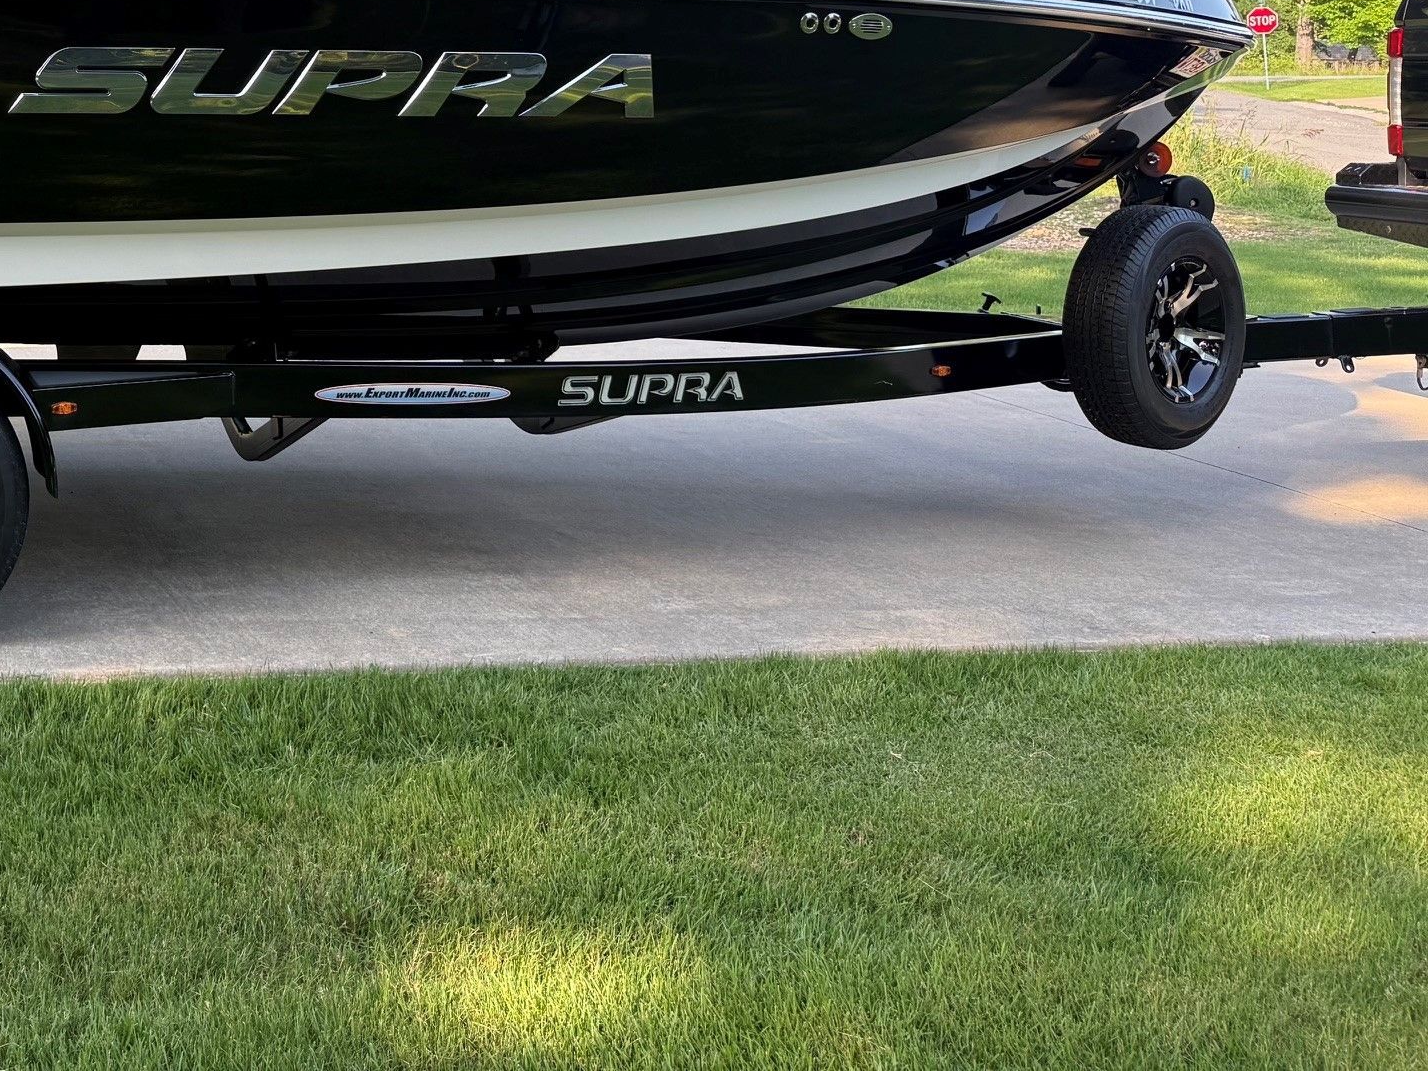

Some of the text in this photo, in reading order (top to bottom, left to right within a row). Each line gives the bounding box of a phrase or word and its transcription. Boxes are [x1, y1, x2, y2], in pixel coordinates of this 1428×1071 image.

[1249, 14, 1276, 27] STOP
[8, 47, 655, 119] SUPRA
[557, 371, 744, 406] SUPRA
